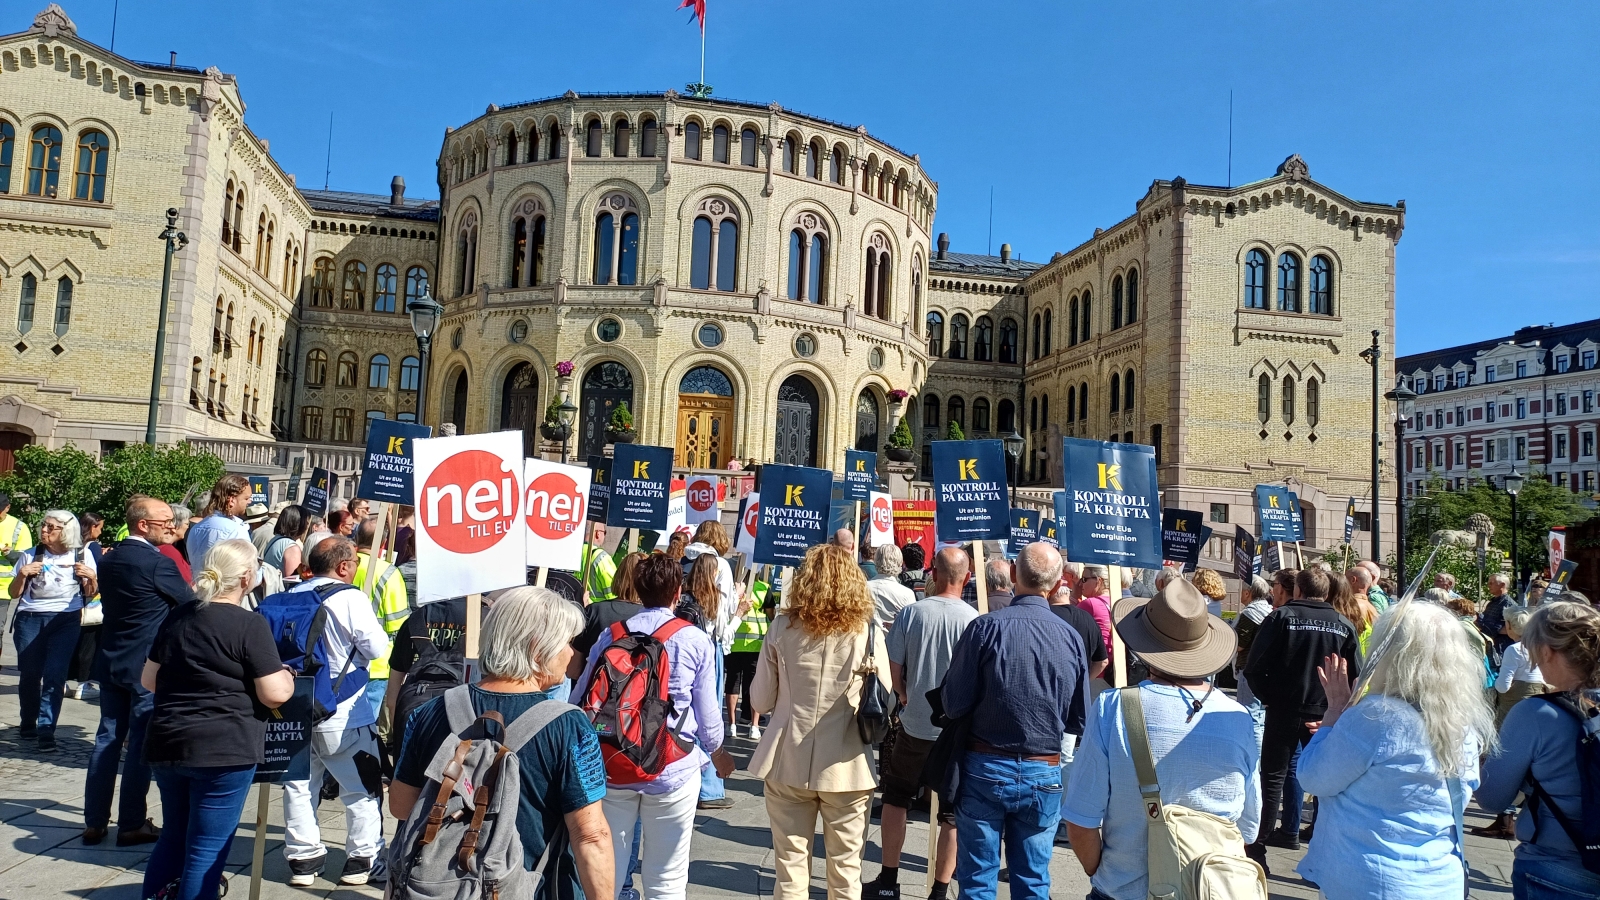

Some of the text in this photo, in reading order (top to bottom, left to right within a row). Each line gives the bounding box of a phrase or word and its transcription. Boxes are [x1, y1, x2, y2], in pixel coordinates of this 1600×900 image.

[368, 460, 379, 469] PÅ
[616, 479, 664, 490] KONTROLL
[941, 482, 1000, 492] KONTROLL
[426, 461, 512, 527] nei
[616, 486, 663, 498] PÅ KRAFTA
[689, 484, 713, 502] nei
[942, 491, 1001, 502] PÅ KRAFTA
[526, 484, 582, 522] nei
[1074, 490, 1150, 507] KONTROLL
[765, 507, 822, 520] KONTROLL
[1074, 501, 1150, 519] PÅ KRAFTA
[548, 521, 562, 532] TIL
[764, 515, 776, 525] PÅ
[778, 518, 821, 530] KRAFTA
[467, 520, 513, 538] TIL EU
[1091, 532, 1137, 542] energiunion
[267, 722, 304, 731] TROLL
[265, 732, 303, 741] RAFTA
